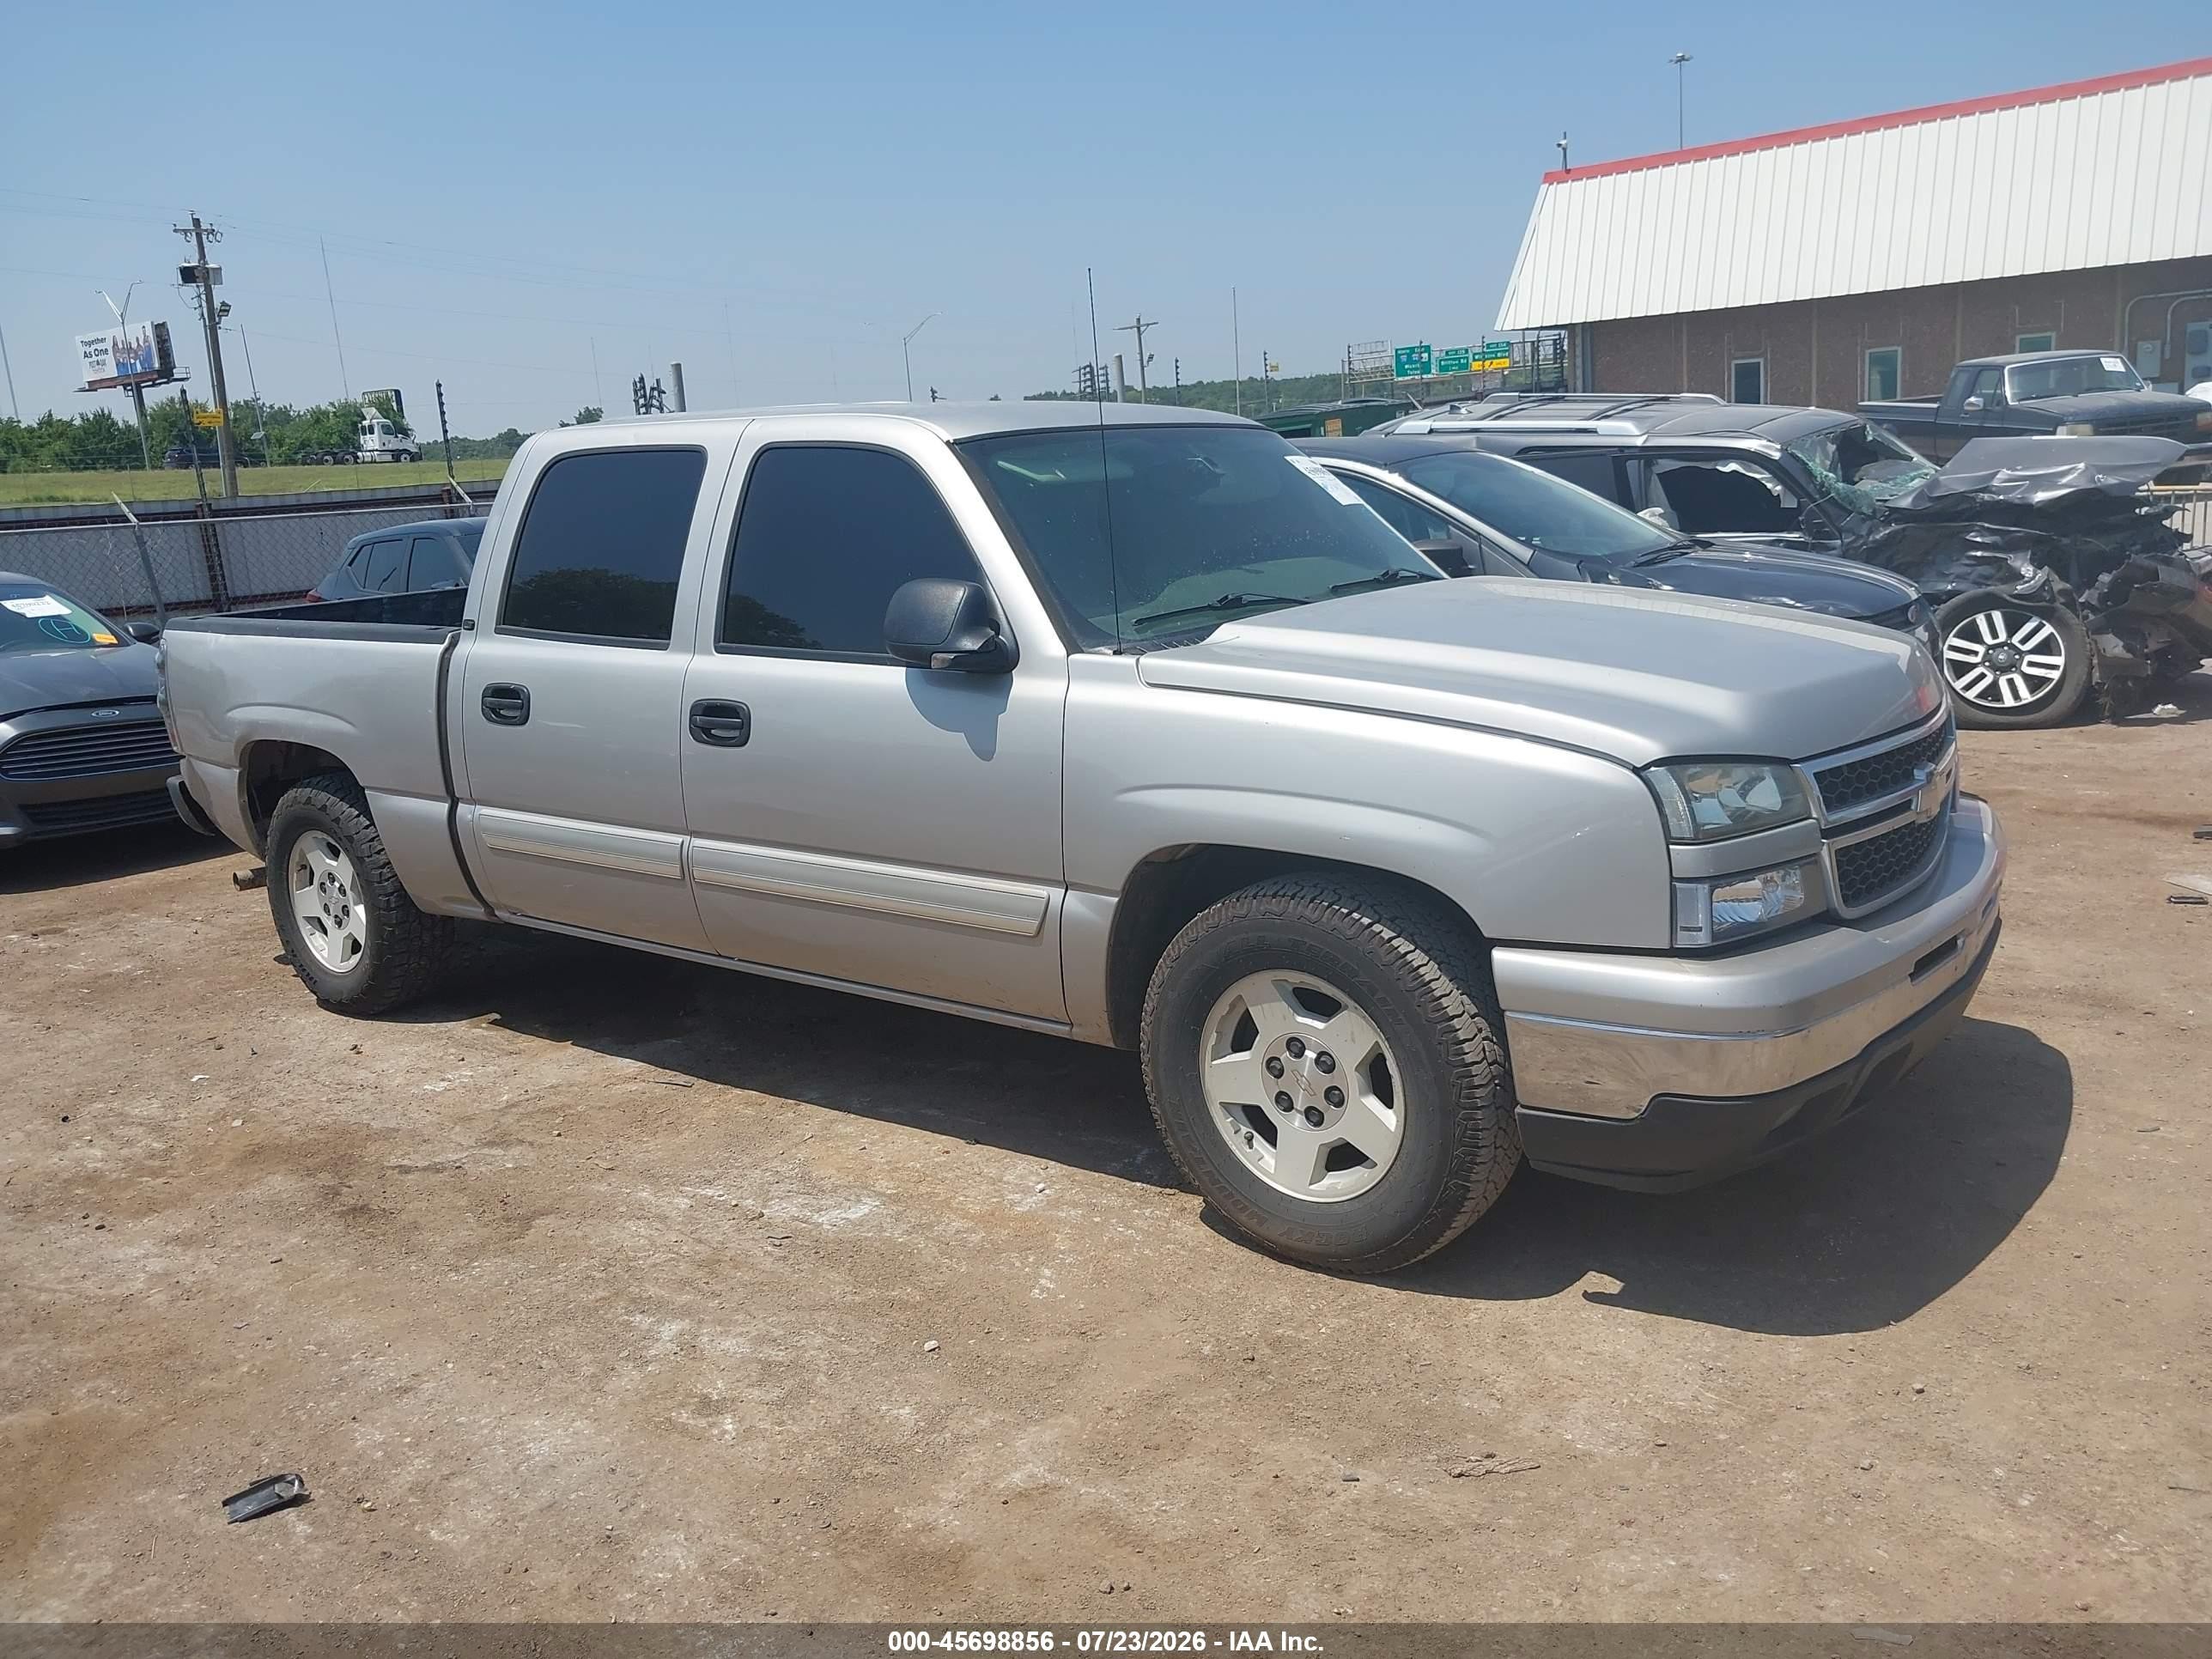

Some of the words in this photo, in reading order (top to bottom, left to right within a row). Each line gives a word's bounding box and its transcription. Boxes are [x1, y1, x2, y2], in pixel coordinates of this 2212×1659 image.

[81, 337, 106, 348] Together
[83, 350, 94, 359] As
[94, 348, 109, 356] One
